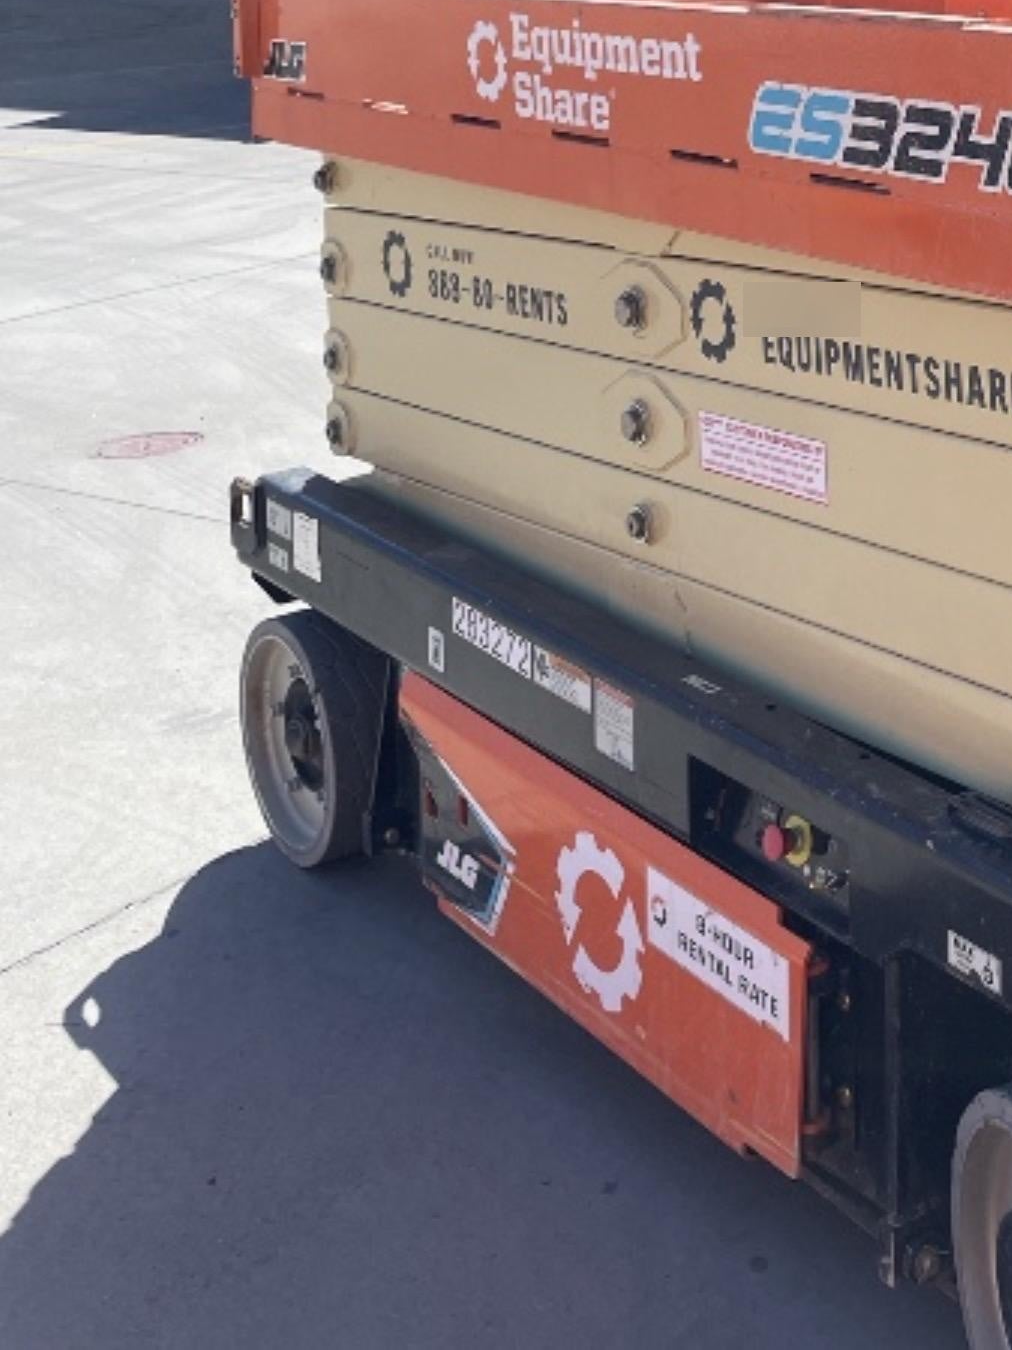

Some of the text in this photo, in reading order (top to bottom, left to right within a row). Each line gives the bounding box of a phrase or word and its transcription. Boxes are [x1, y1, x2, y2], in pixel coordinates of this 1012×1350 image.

[510, 13, 702, 81] Equipment
[513, 72, 610, 130] Share
[453, 601, 531, 679] 283272
[437, 840, 480, 889] JLG
[677, 930, 778, 1018] RENTAL RATE
